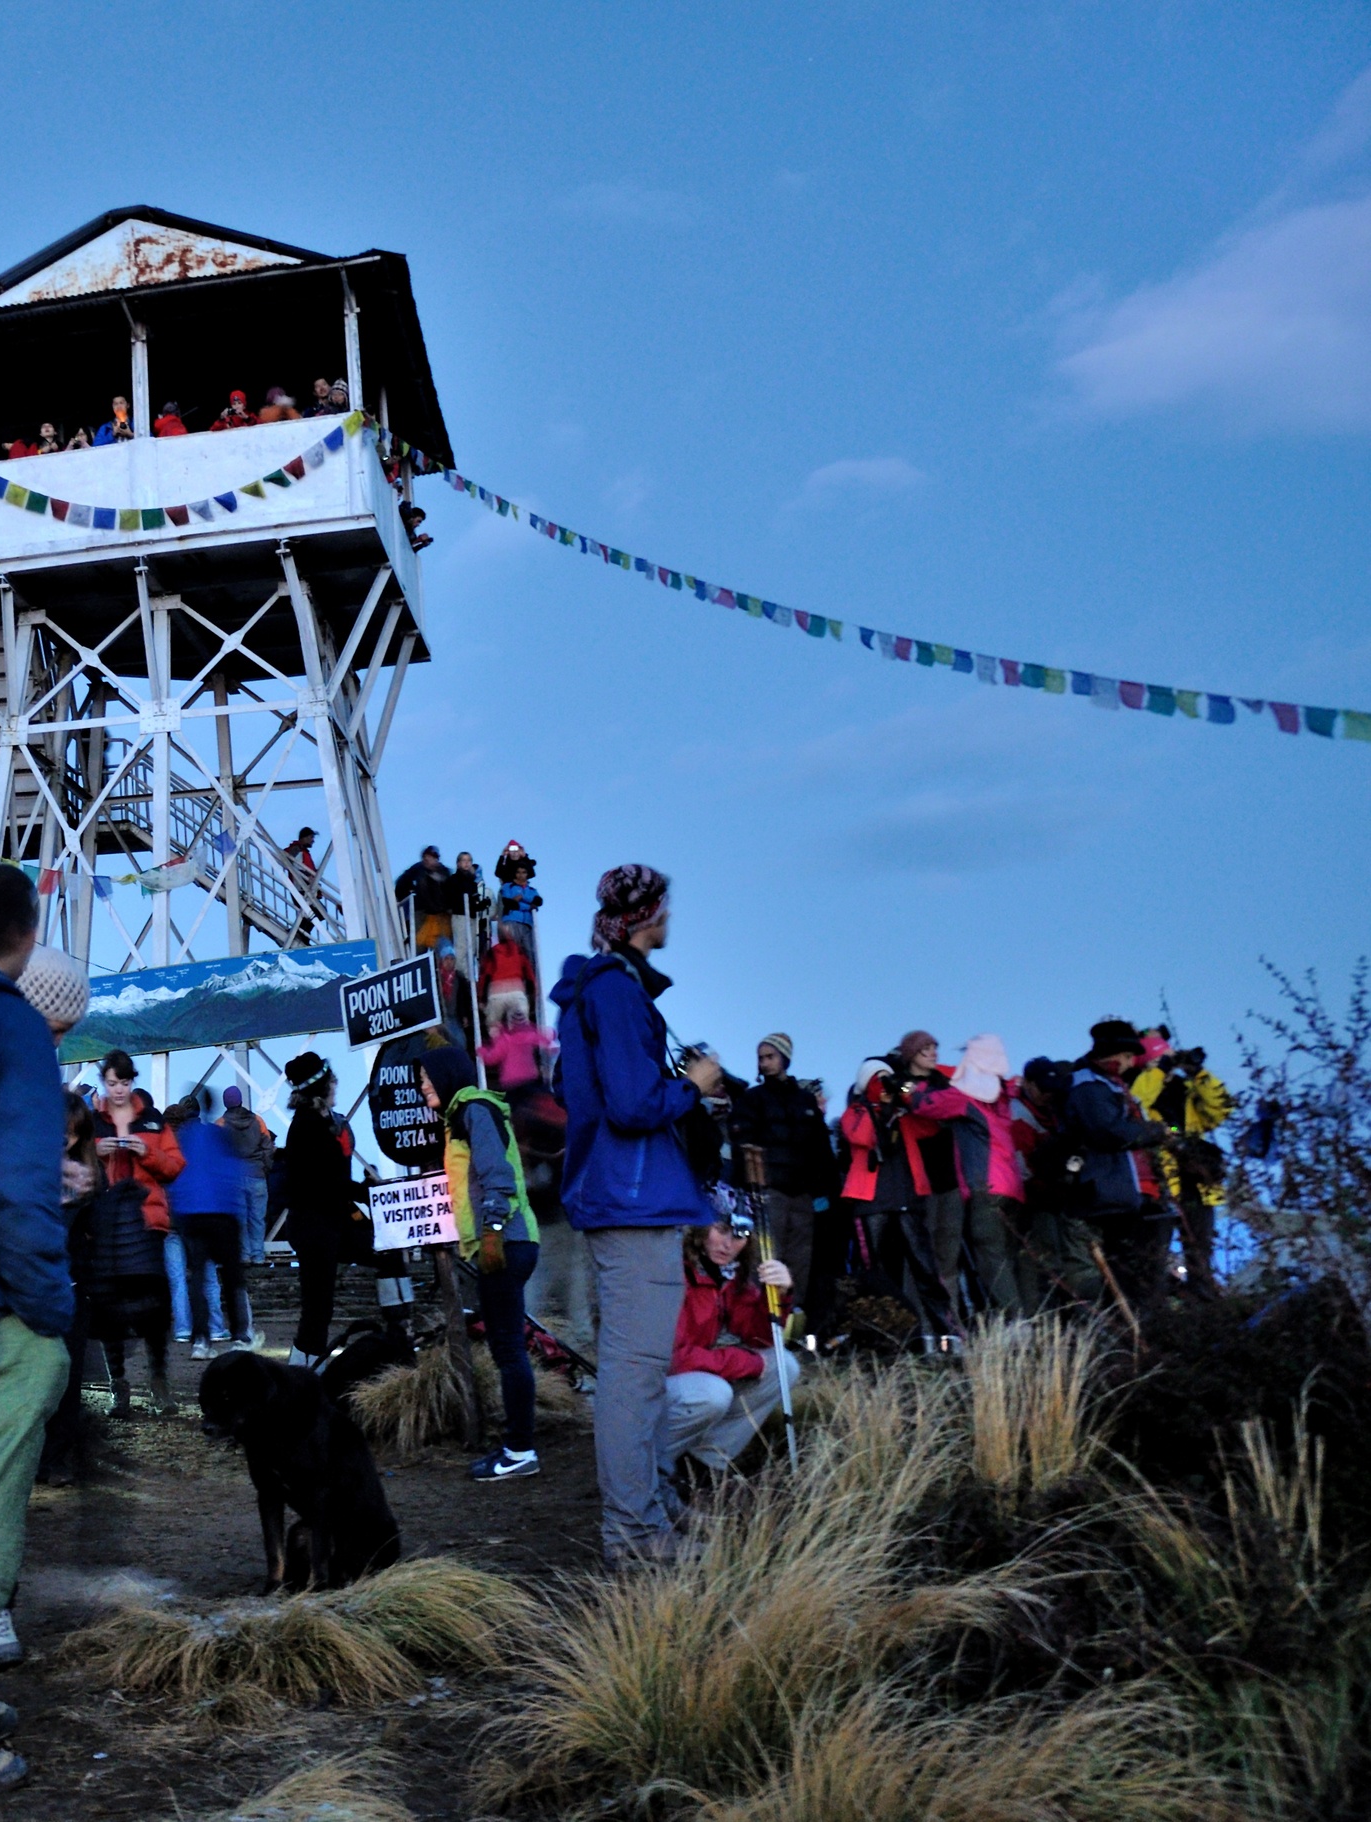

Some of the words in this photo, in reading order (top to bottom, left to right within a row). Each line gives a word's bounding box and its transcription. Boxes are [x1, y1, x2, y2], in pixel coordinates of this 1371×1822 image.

[348, 980, 390, 1018] POON
[392, 968, 427, 1004] HILL
[368, 1009, 393, 1036] 3210
[379, 1065, 408, 1086] POON
[394, 1088, 417, 1105] 3210
[395, 1128, 427, 1149] 2874
[372, 1190, 400, 1207] POON
[403, 1186, 429, 1202] HILL
[383, 1204, 433, 1224] VISITORS
[407, 1222, 442, 1239] AREA
